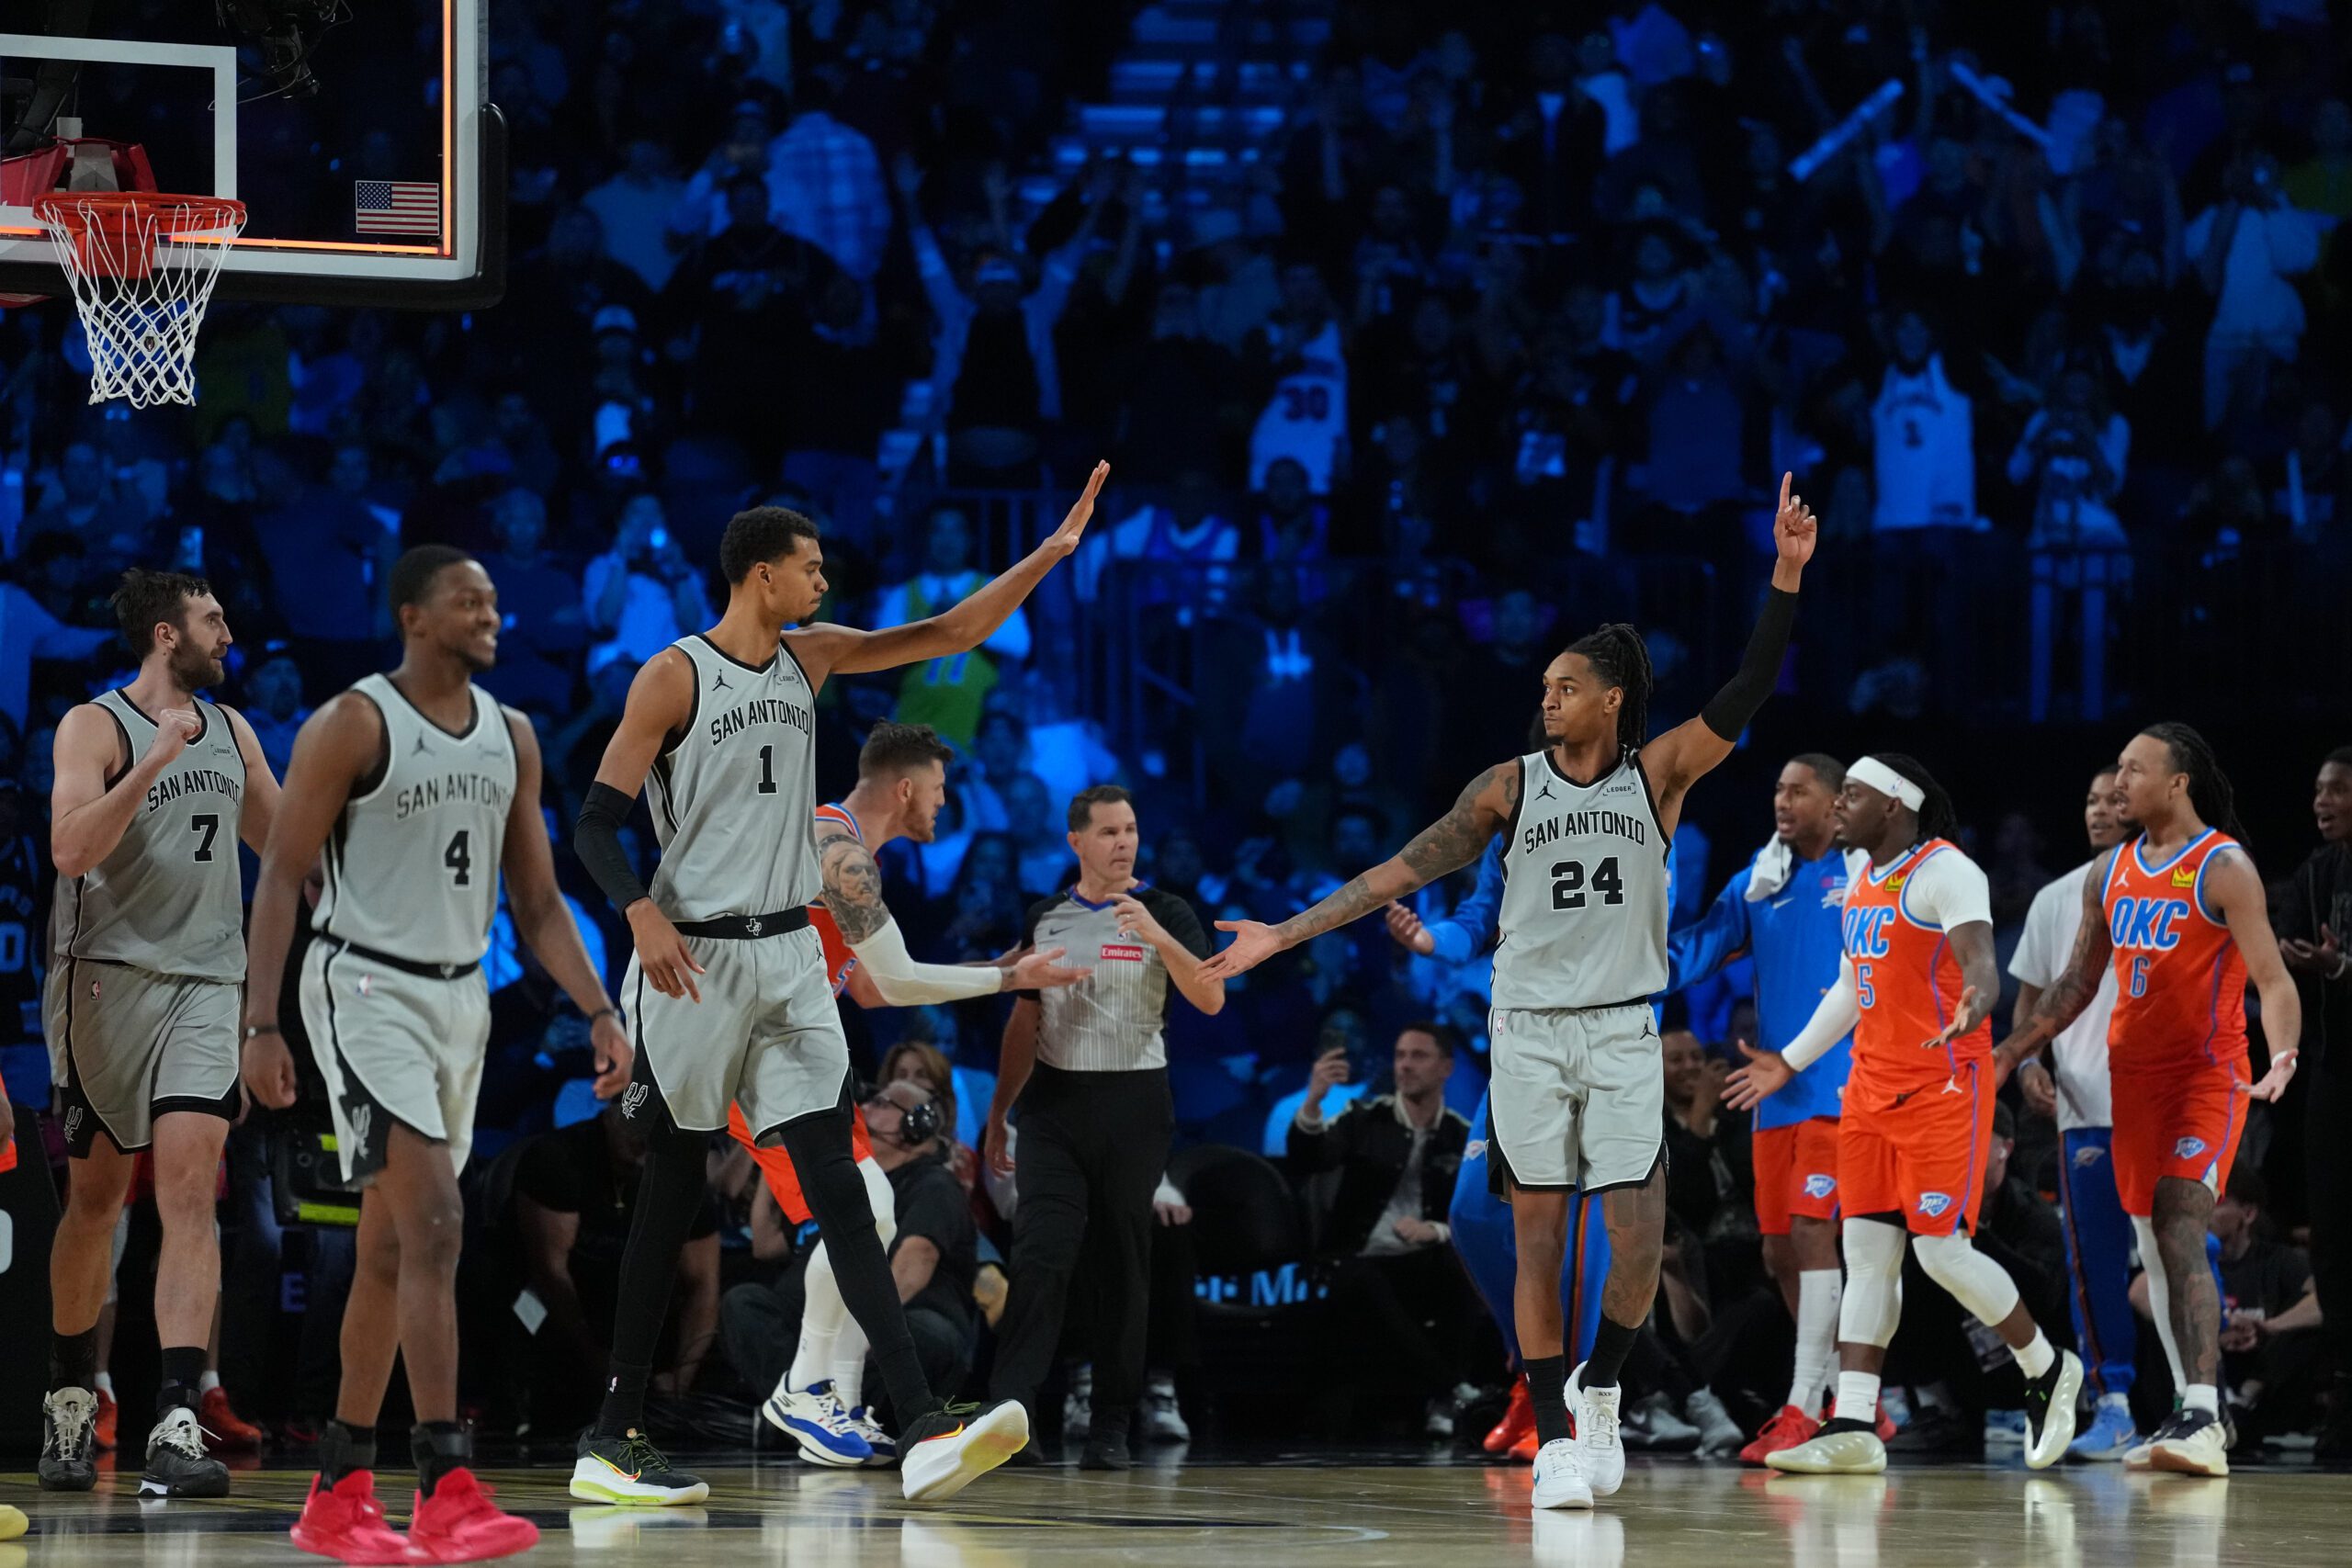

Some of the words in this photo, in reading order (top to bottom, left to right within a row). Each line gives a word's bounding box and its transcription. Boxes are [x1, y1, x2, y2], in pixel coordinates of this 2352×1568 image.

[710, 706, 745, 746] SAN
[749, 699, 808, 736] ANTONIO
[758, 744, 777, 794] 1
[148, 774, 182, 813] SAN
[396, 778, 439, 820] SAN
[191, 814, 219, 863] 7
[1524, 816, 1559, 854] SAN
[1565, 810, 1645, 847] ANTONIO
[445, 829, 471, 886] 4
[1550, 856, 1624, 911] 24
[1843, 906, 1896, 959] OKC
[2111, 896, 2190, 952] OKC
[1102, 947, 1142, 958] Emirates
[2130, 954, 2151, 998] 6
[1858, 964, 1875, 1009] 5
